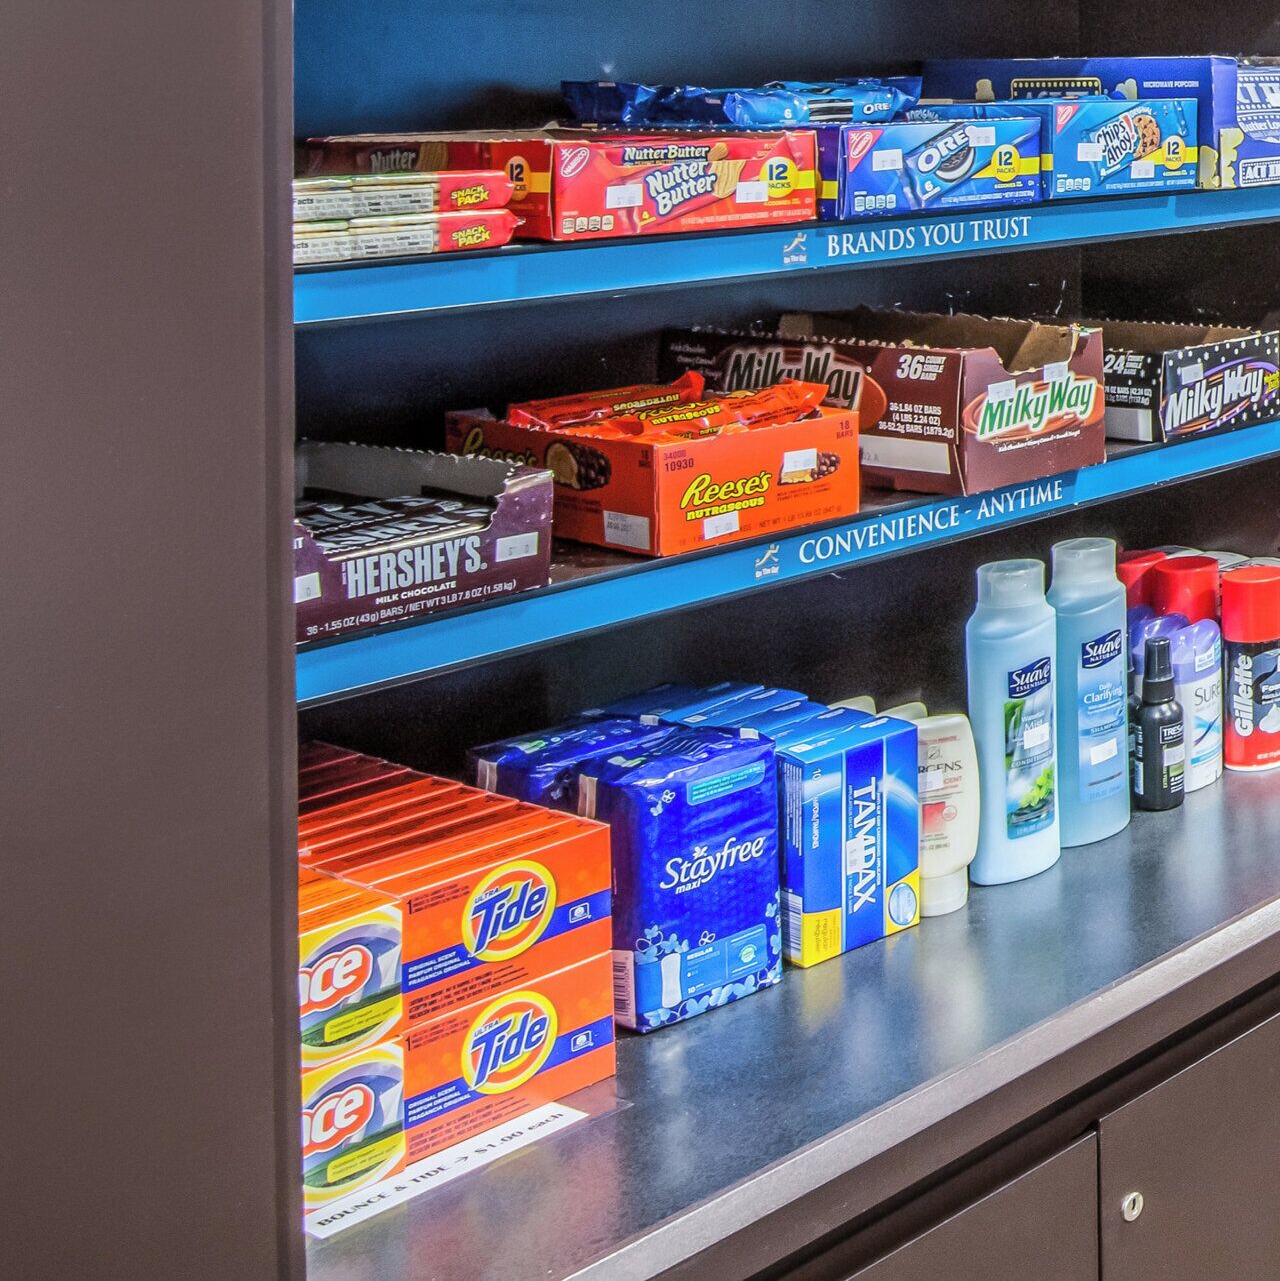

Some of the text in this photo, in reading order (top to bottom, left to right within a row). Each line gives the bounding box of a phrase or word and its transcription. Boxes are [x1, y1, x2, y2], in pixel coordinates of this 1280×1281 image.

[1143, 80, 1199, 89] MICROWAVE POPCORN
[1096, 119, 1126, 145] Chips
[624, 146, 710, 162] Nutter Butter
[997, 150, 1012, 166] 12
[1166, 141, 1181, 156] 12
[509, 163, 524, 182] 12
[645, 160, 708, 198] Nutter
[768, 164, 788, 181] 12
[996, 166, 1016, 174] PACKS
[451, 184, 485, 200] SNACK
[658, 174, 717, 215] Butter
[767, 181, 792, 190] PACKS
[456, 191, 489, 207] PACK
[452, 225, 486, 241] SNACK
[458, 232, 491, 248] PACK
[828, 216, 1032, 257] BRANDS YOU TRUST
[896, 354, 923, 380] 36
[1104, 352, 1127, 375] 24
[976, 372, 1095, 441] Milky Way
[1164, 364, 1264, 432] Milky Way
[839, 420, 850, 430] 18
[664, 460, 695, 471] 10930
[680, 470, 772, 510] Reese's
[686, 496, 765, 522] NUTRAGEOUS
[799, 507, 959, 564] CONVENIENCE
[977, 479, 1063, 519] ANYTIME
[347, 535, 482, 600] HERSHEY'S
[376, 580, 457, 605] MILK CHOCOLATE
[306, 625, 319, 636] 36
[324, 620, 343, 633] 1.55
[343, 617, 355, 628] OZ
[380, 605, 404, 620] BARS
[409, 601, 424, 614] NET
[424, 598, 441, 610] WT
[447, 593, 458, 605] LB
[458, 590, 471, 602] 7.8
[471, 587, 483, 599] OZ
[1085, 636, 1122, 662] Suave
[1090, 648, 1119, 664] NATURALS
[1010, 660, 1053, 688] Suave
[1083, 683, 1122, 706] Clarifying
[1194, 682, 1222, 706] SURE
[1235, 653, 1254, 737] Gillette
[853, 776, 879, 914] TAMPAX
[660, 836, 767, 890] Stayfree
[475, 886, 503, 904] ULTRA
[676, 878, 703, 895] maxi
[471, 879, 550, 958] Tide
[475, 1020, 502, 1037] ULTRA
[470, 1009, 550, 1090] Tide
[316, 1191, 391, 1227] BOUNCE
[411, 1165, 452, 1183] TIDE
[474, 1129, 524, 1154] $1.00
[528, 1112, 567, 1132] each
